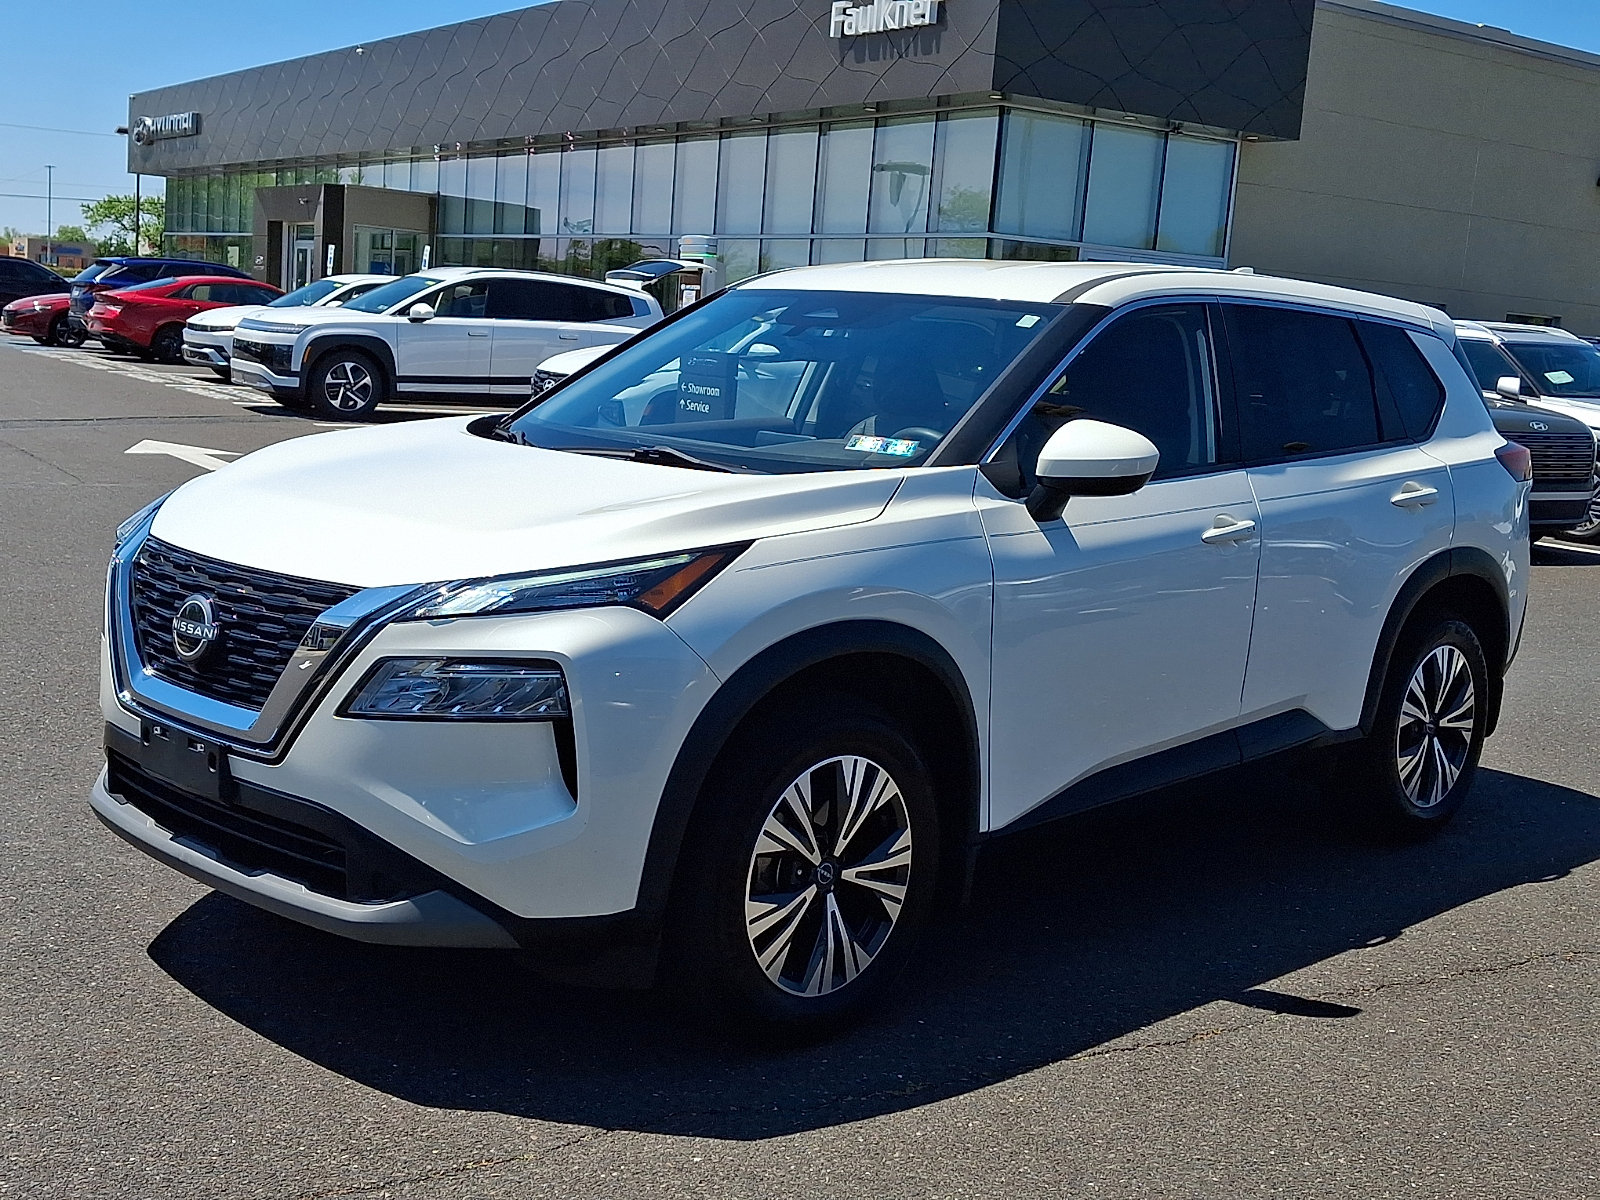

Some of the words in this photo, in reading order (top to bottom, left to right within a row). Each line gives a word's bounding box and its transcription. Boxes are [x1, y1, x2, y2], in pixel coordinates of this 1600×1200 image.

[829, 0, 938, 38] Faulkner
[687, 382, 720, 397] Showroom
[685, 399, 710, 413] Service
[172, 616, 214, 639] NISSAN
